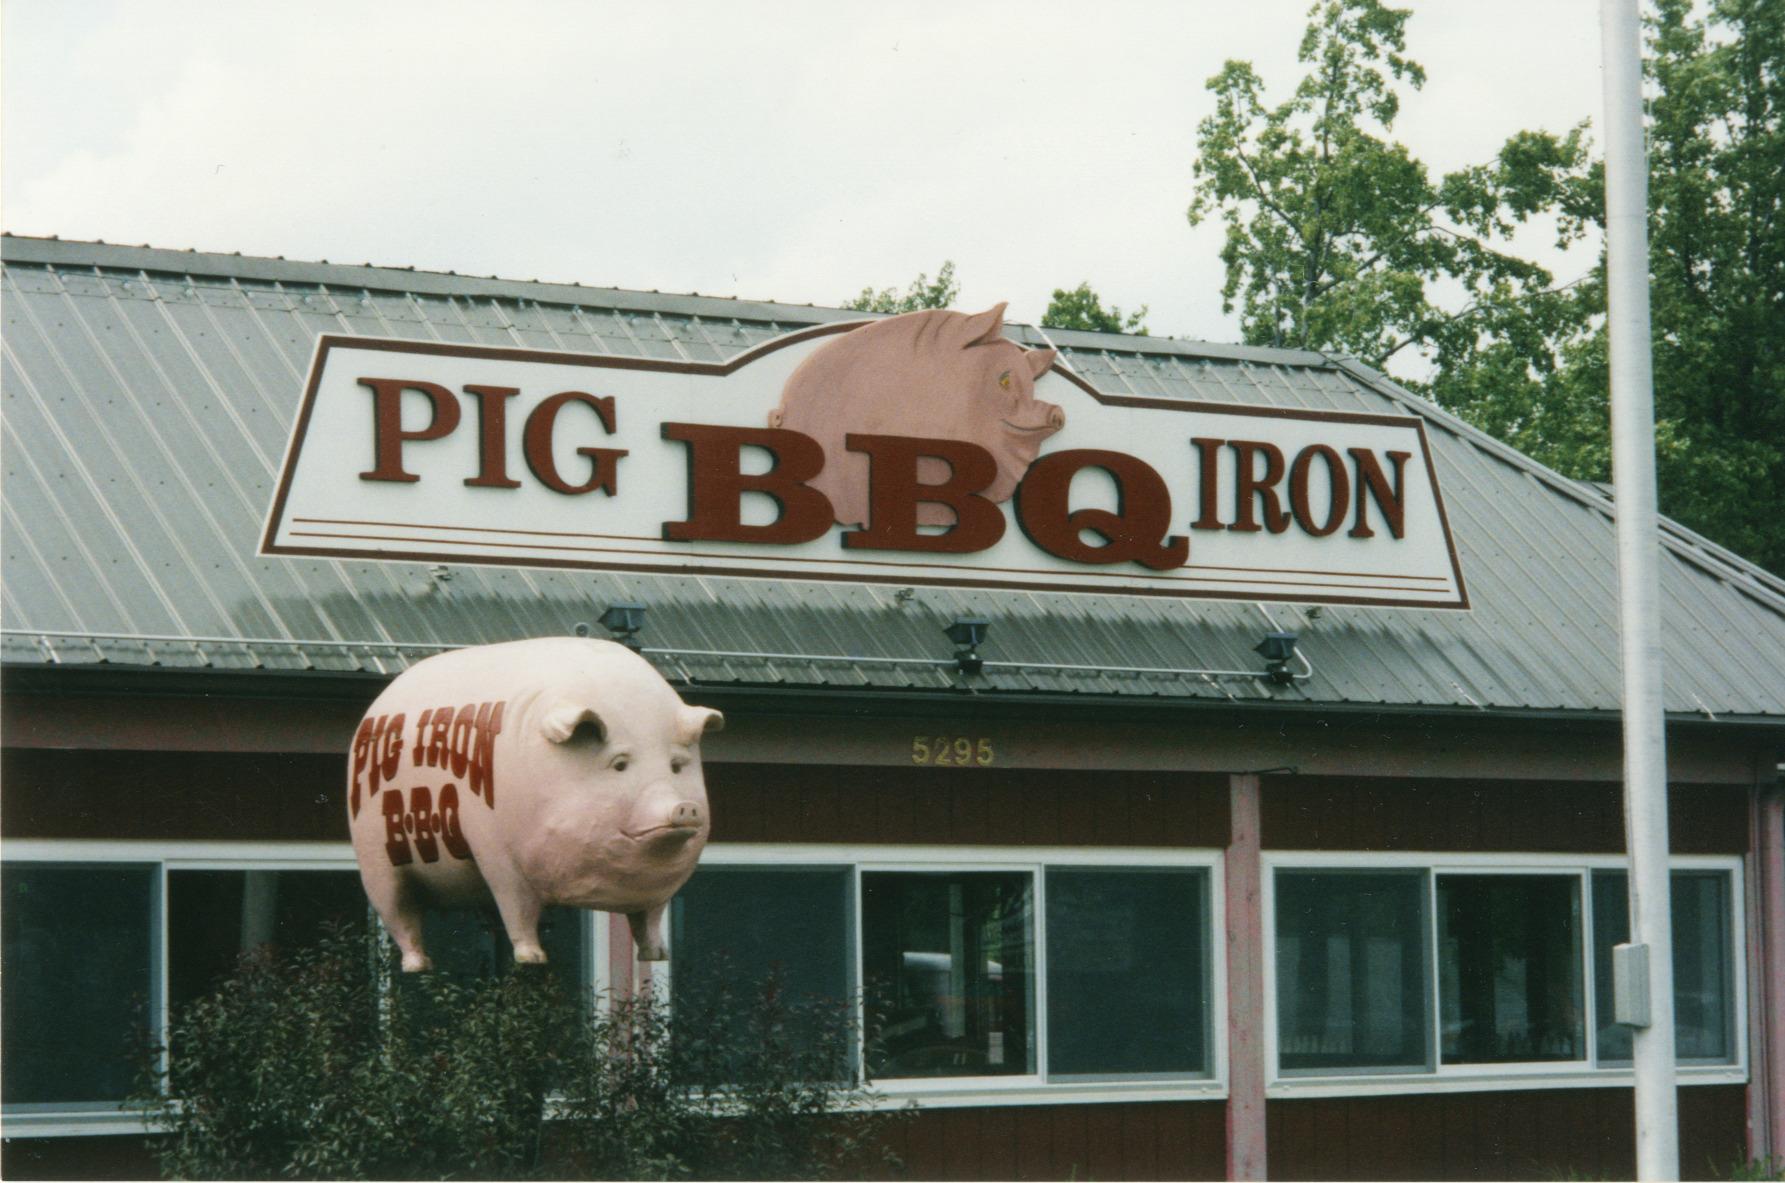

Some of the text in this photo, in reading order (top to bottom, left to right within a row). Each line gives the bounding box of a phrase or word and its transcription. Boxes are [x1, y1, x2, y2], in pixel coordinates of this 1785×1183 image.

[357, 377, 1412, 571] PIG BBQ IRON
[350, 700, 506, 821] PIG IRON
[911, 736, 995, 768] 5295
